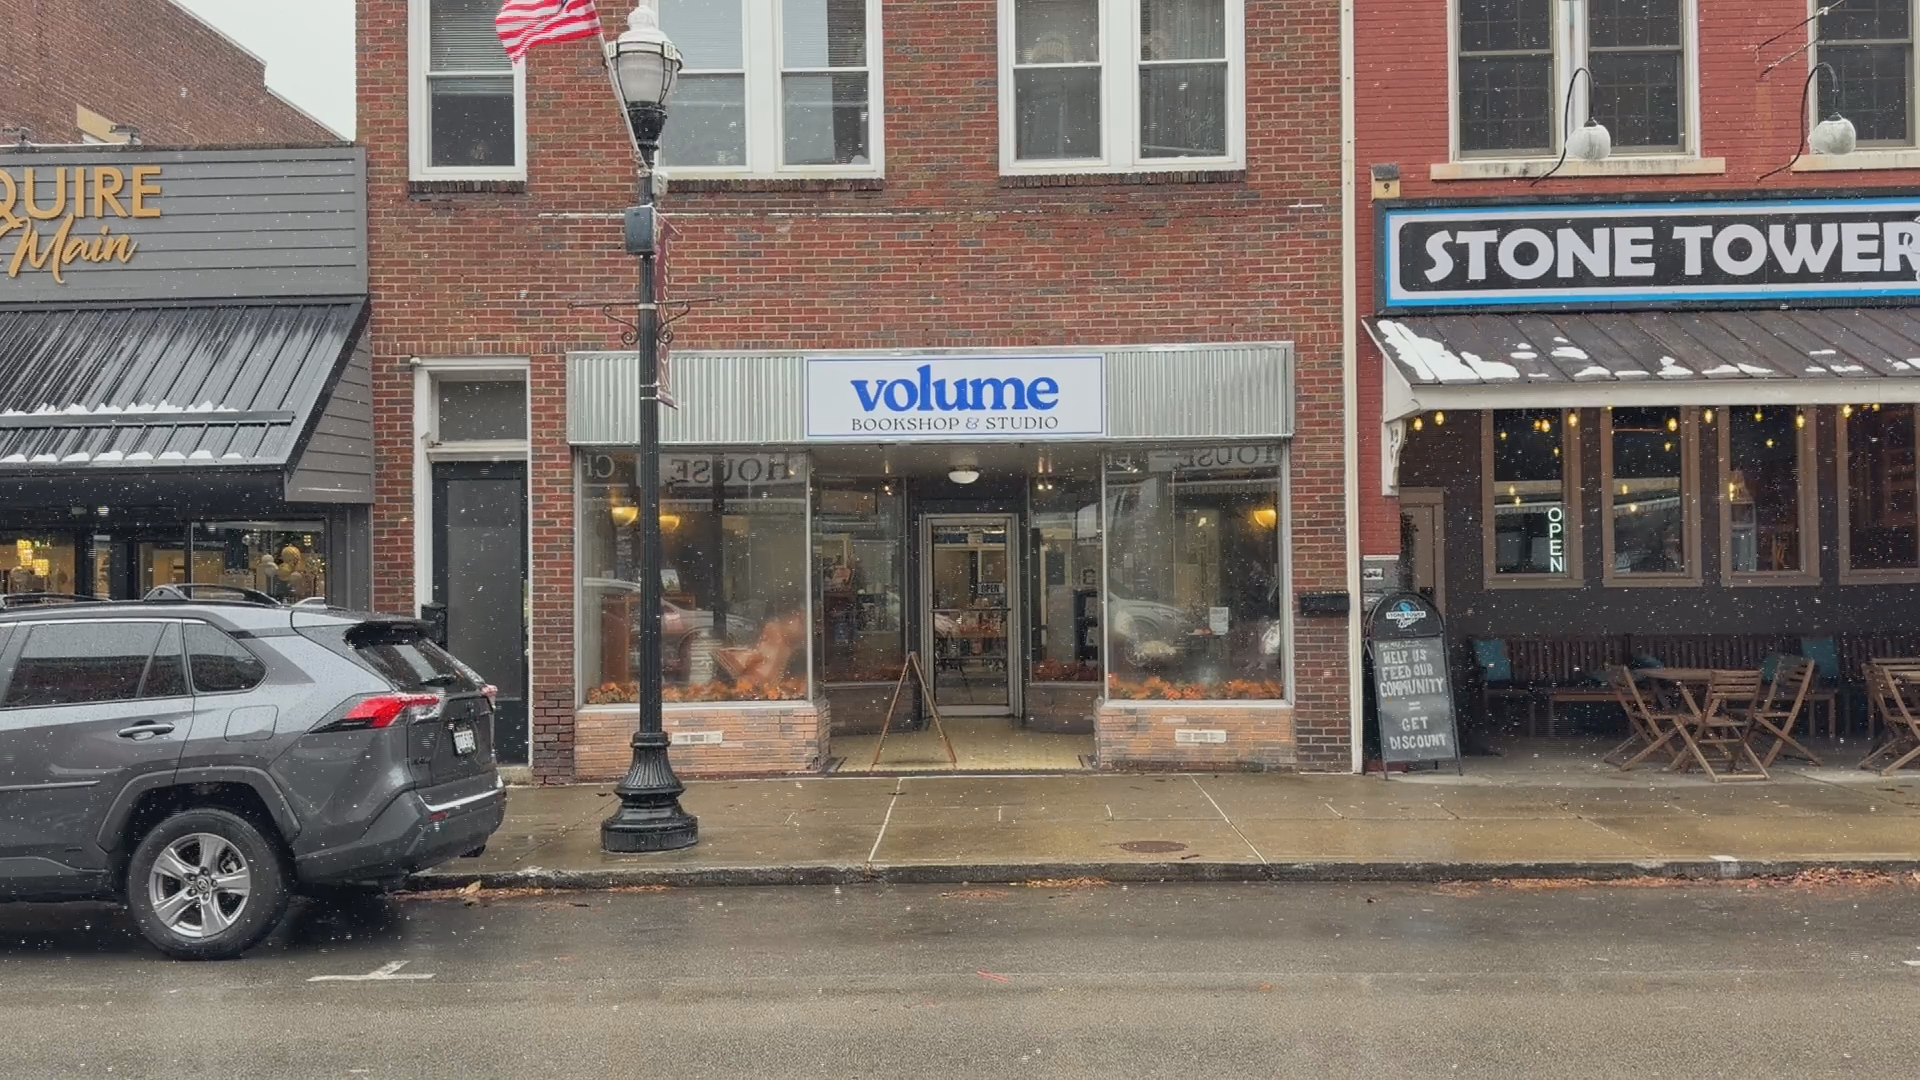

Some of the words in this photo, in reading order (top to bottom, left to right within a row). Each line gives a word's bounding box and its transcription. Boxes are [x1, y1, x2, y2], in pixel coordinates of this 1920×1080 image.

[8, 213, 138, 284] Main
[1424, 226, 1657, 283] STONE
[1672, 221, 1920, 277] TOWER
[850, 364, 1059, 412] volume
[851, 417, 960, 431] BOOKSHOP
[965, 417, 979, 431] &
[986, 416, 1059, 430] STUDIO
[1548, 507, 1562, 572] OPEN
[980, 584, 1000, 593] OPEN
[1382, 650, 1408, 664] HELP
[1412, 649, 1427, 662] US
[1381, 665, 1411, 681] FEED
[1413, 663, 1434, 676] OUR
[1380, 676, 1444, 698] COMMUNITY
[1402, 716, 1428, 732] GET
[1389, 733, 1447, 750] DISCOUNT
